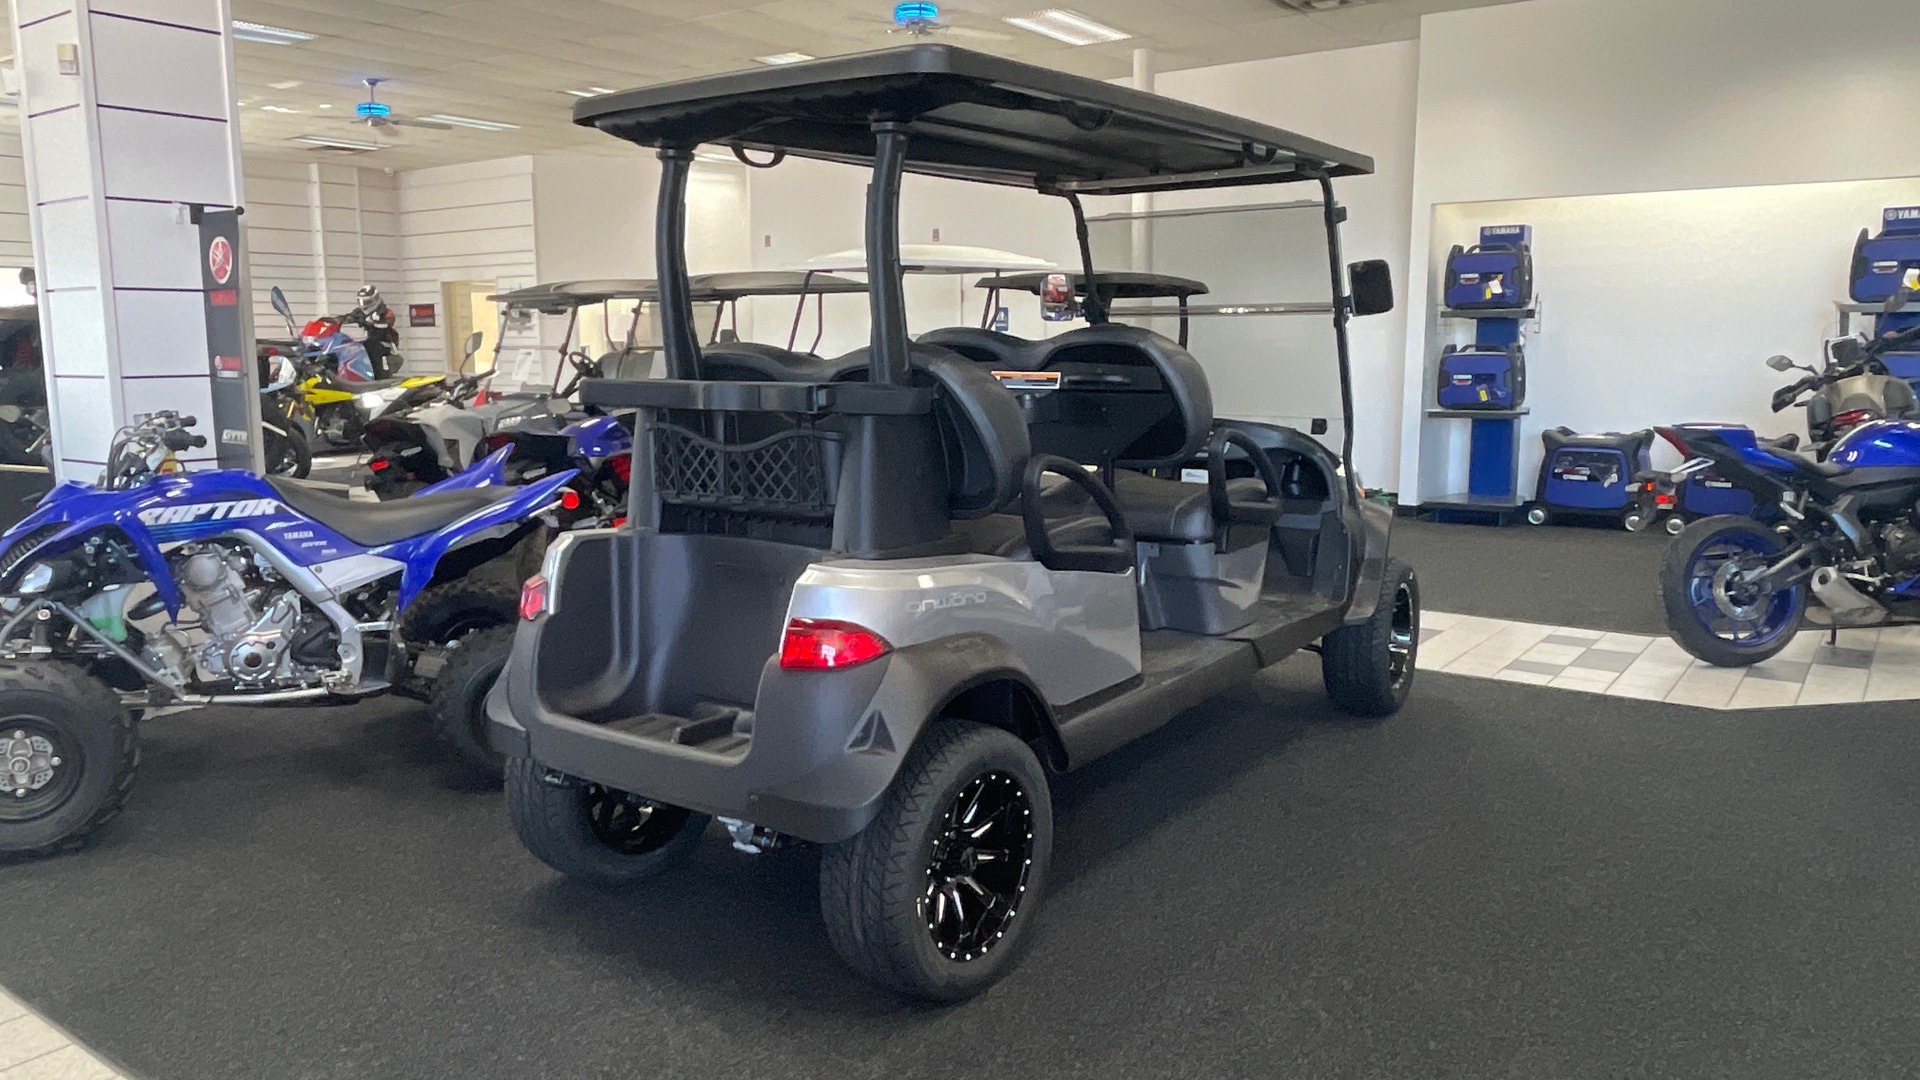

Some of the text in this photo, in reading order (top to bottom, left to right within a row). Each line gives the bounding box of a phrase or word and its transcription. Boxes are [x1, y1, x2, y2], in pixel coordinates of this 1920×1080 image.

[1898, 209, 1920, 219] YAM
[137, 498, 277, 526] RAPTOR
[283, 530, 314, 539] YAMAHA
